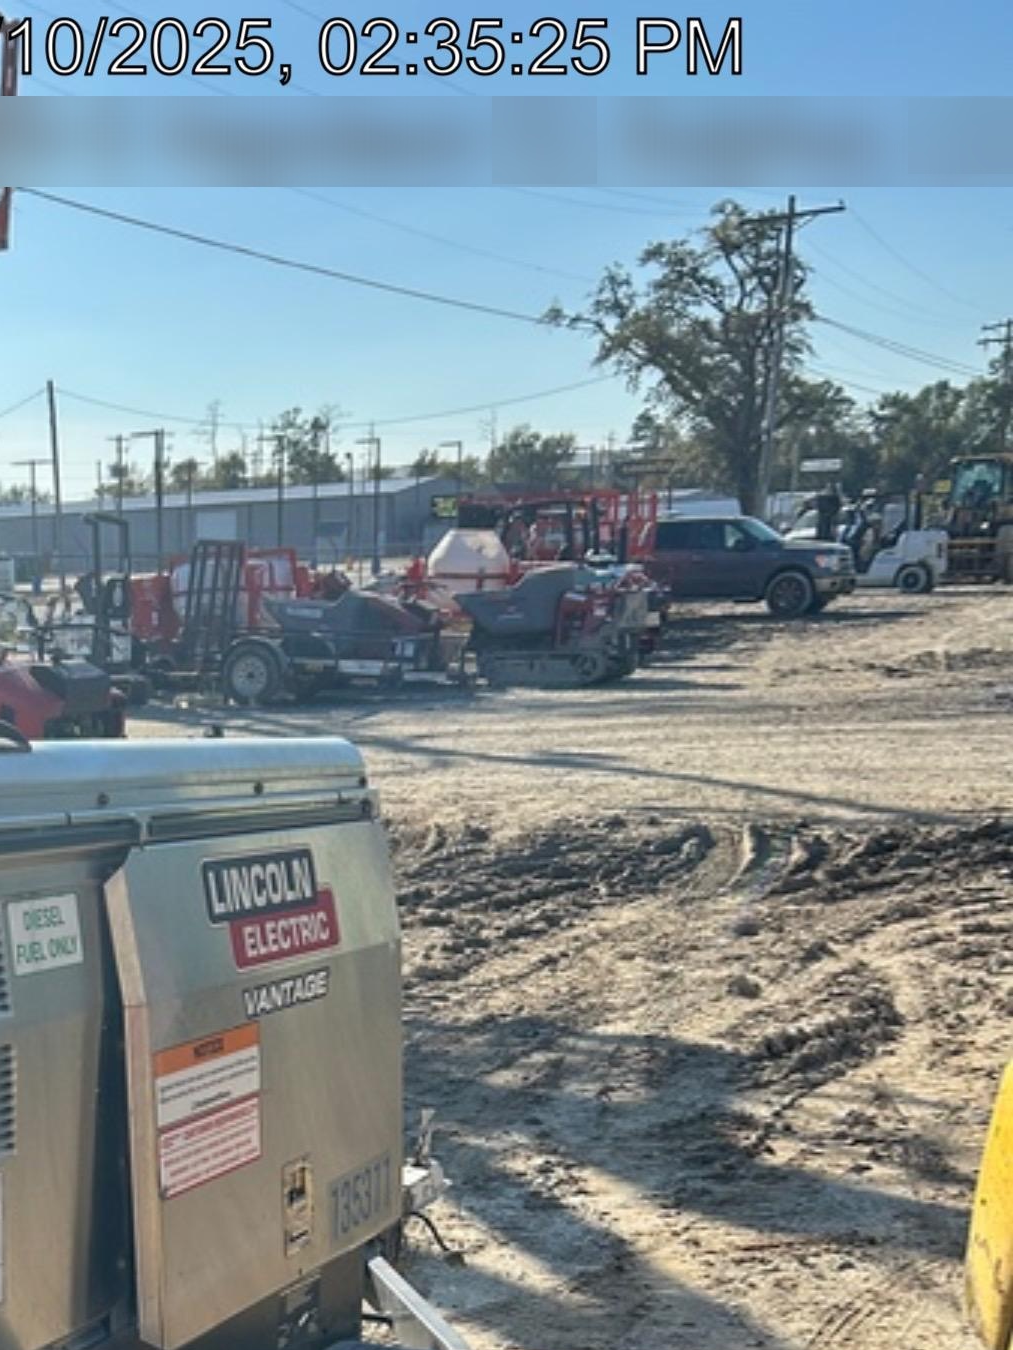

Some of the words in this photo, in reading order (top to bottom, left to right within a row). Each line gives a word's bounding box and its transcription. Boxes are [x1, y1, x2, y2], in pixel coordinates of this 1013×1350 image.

[207, 856, 314, 916] LINCOLN
[23, 906, 64, 931] DIESEL
[242, 910, 331, 959] ELECTRIC
[17, 942, 47, 964] FUEL
[48, 935, 78, 958] ONLY
[242, 970, 329, 1018] VANTAGE
